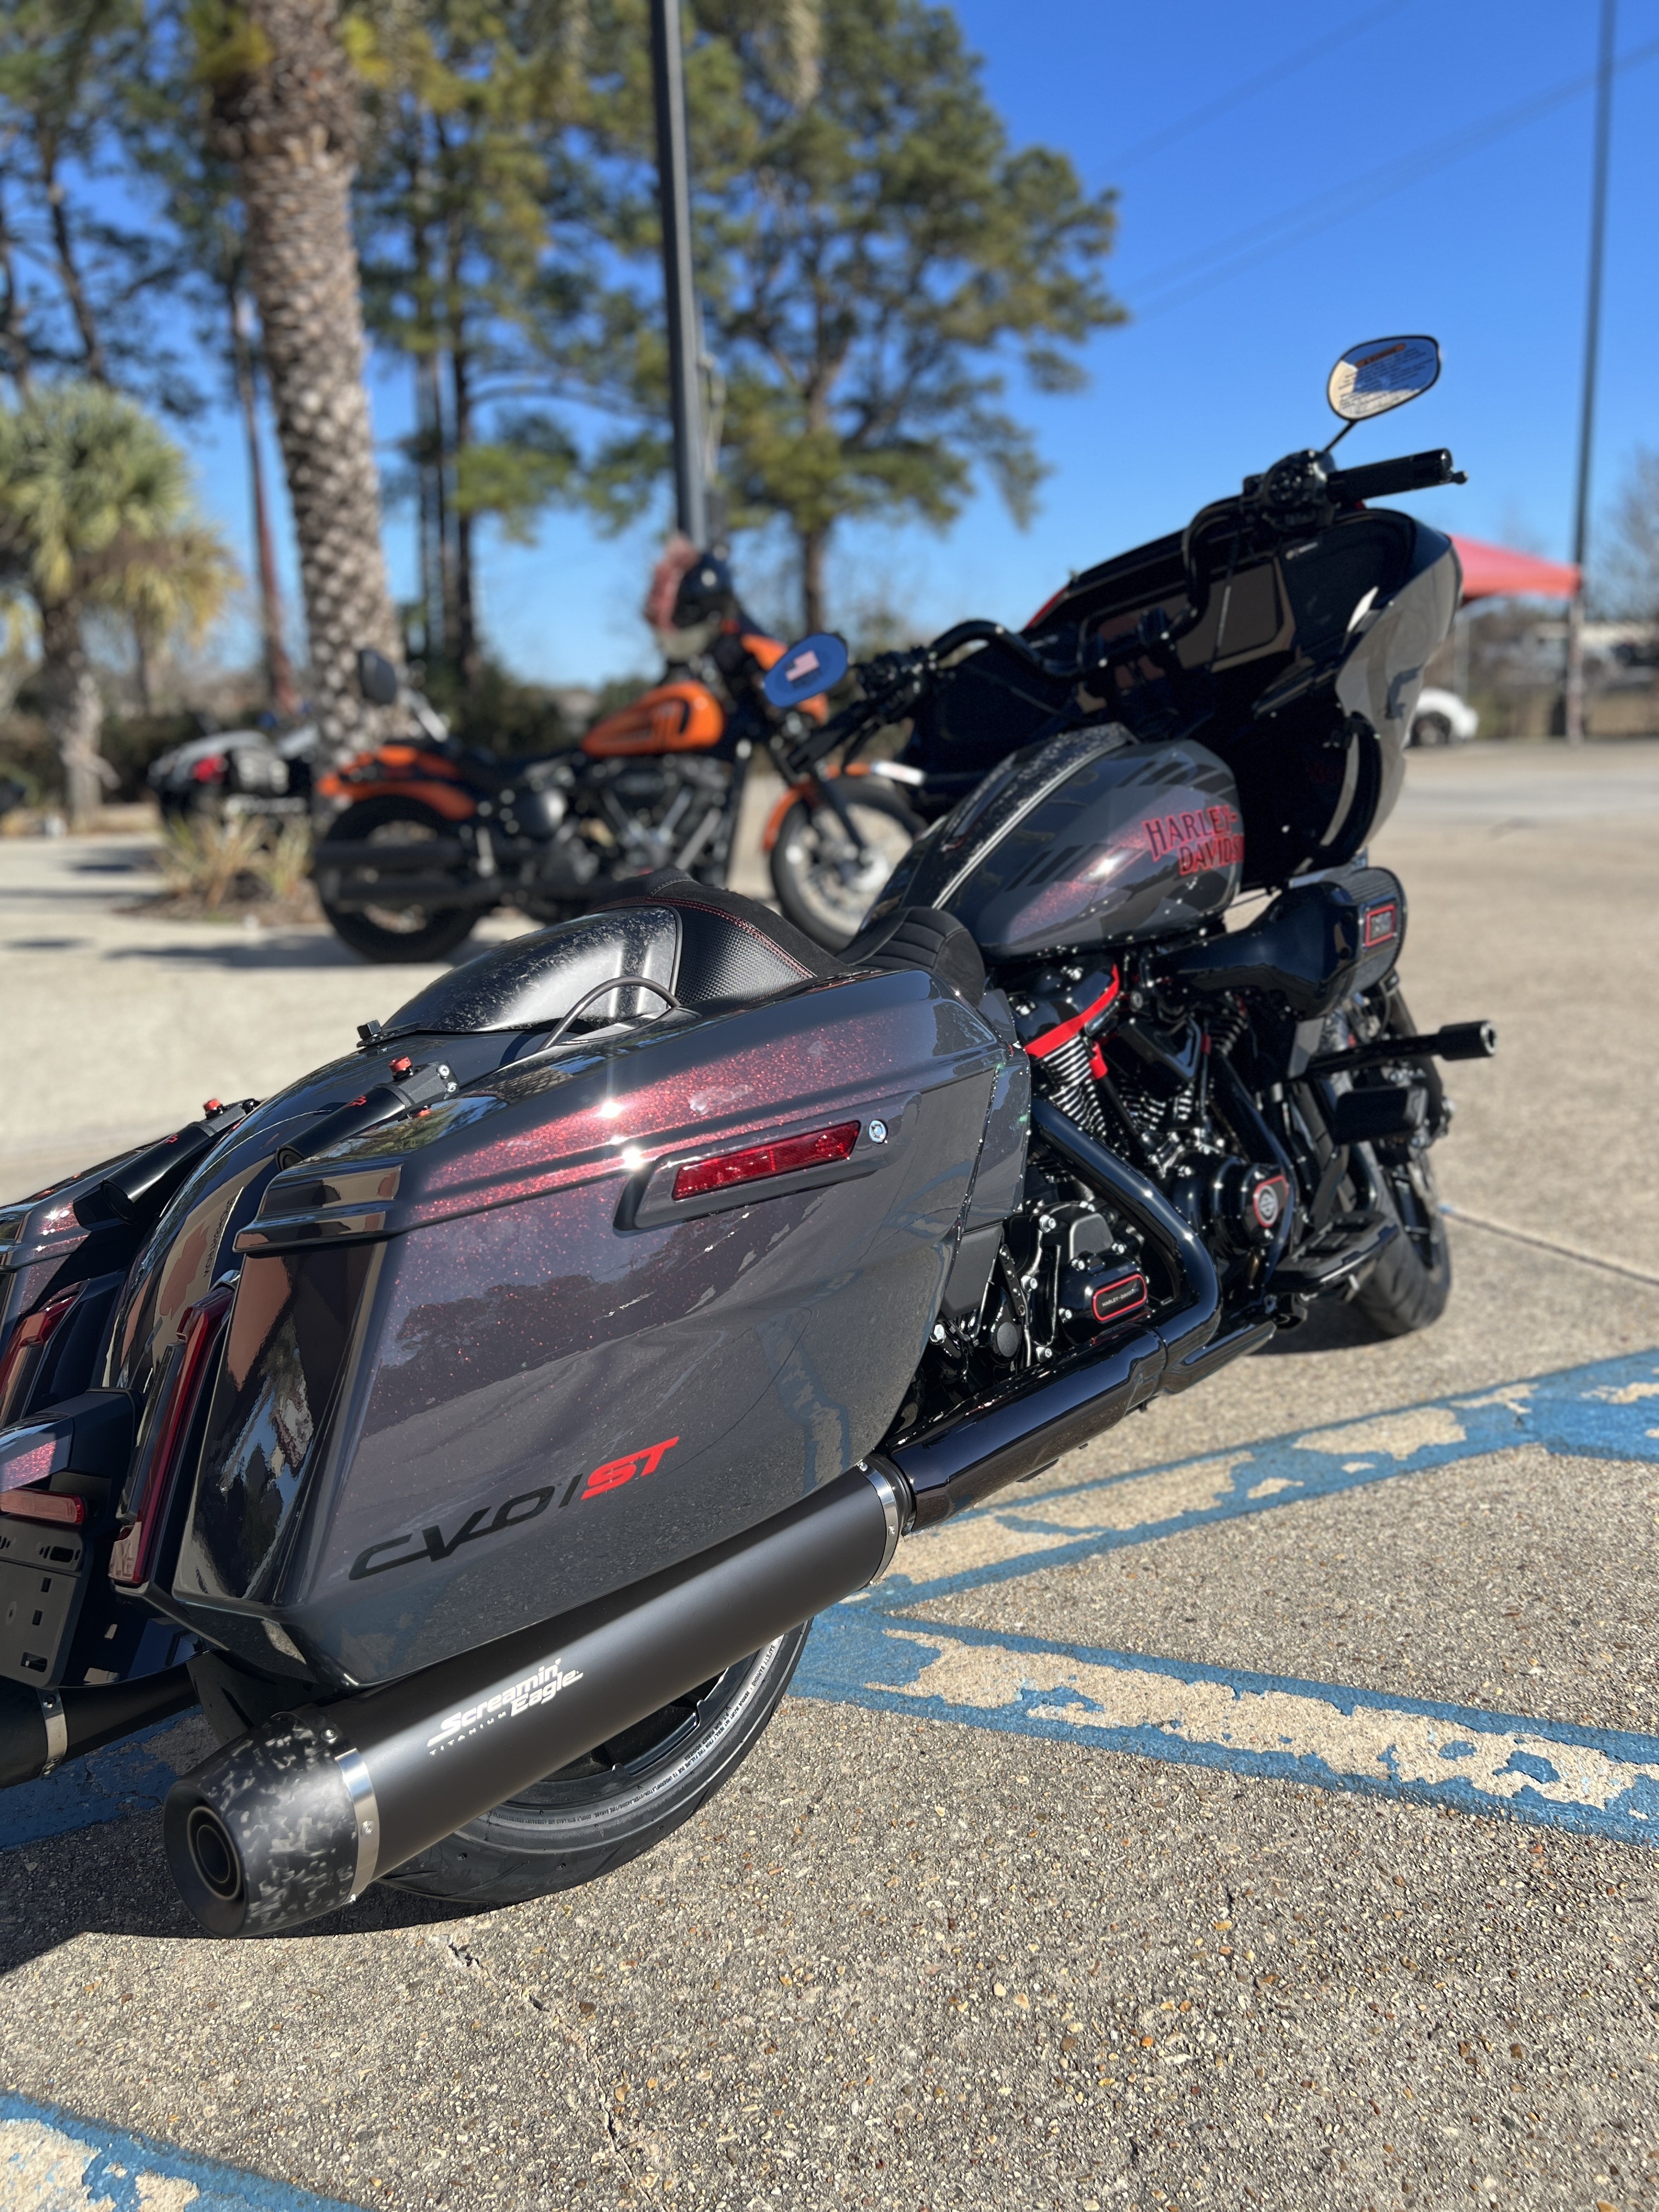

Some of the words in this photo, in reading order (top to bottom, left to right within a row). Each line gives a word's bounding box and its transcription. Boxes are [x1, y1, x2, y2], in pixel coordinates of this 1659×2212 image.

[1142, 805, 1238, 863] HARLEY-
[1178, 833, 1245, 877] DAVIDS
[511, 1670, 583, 1717] Eagle
[429, 1711, 506, 1756] TITANIUM
